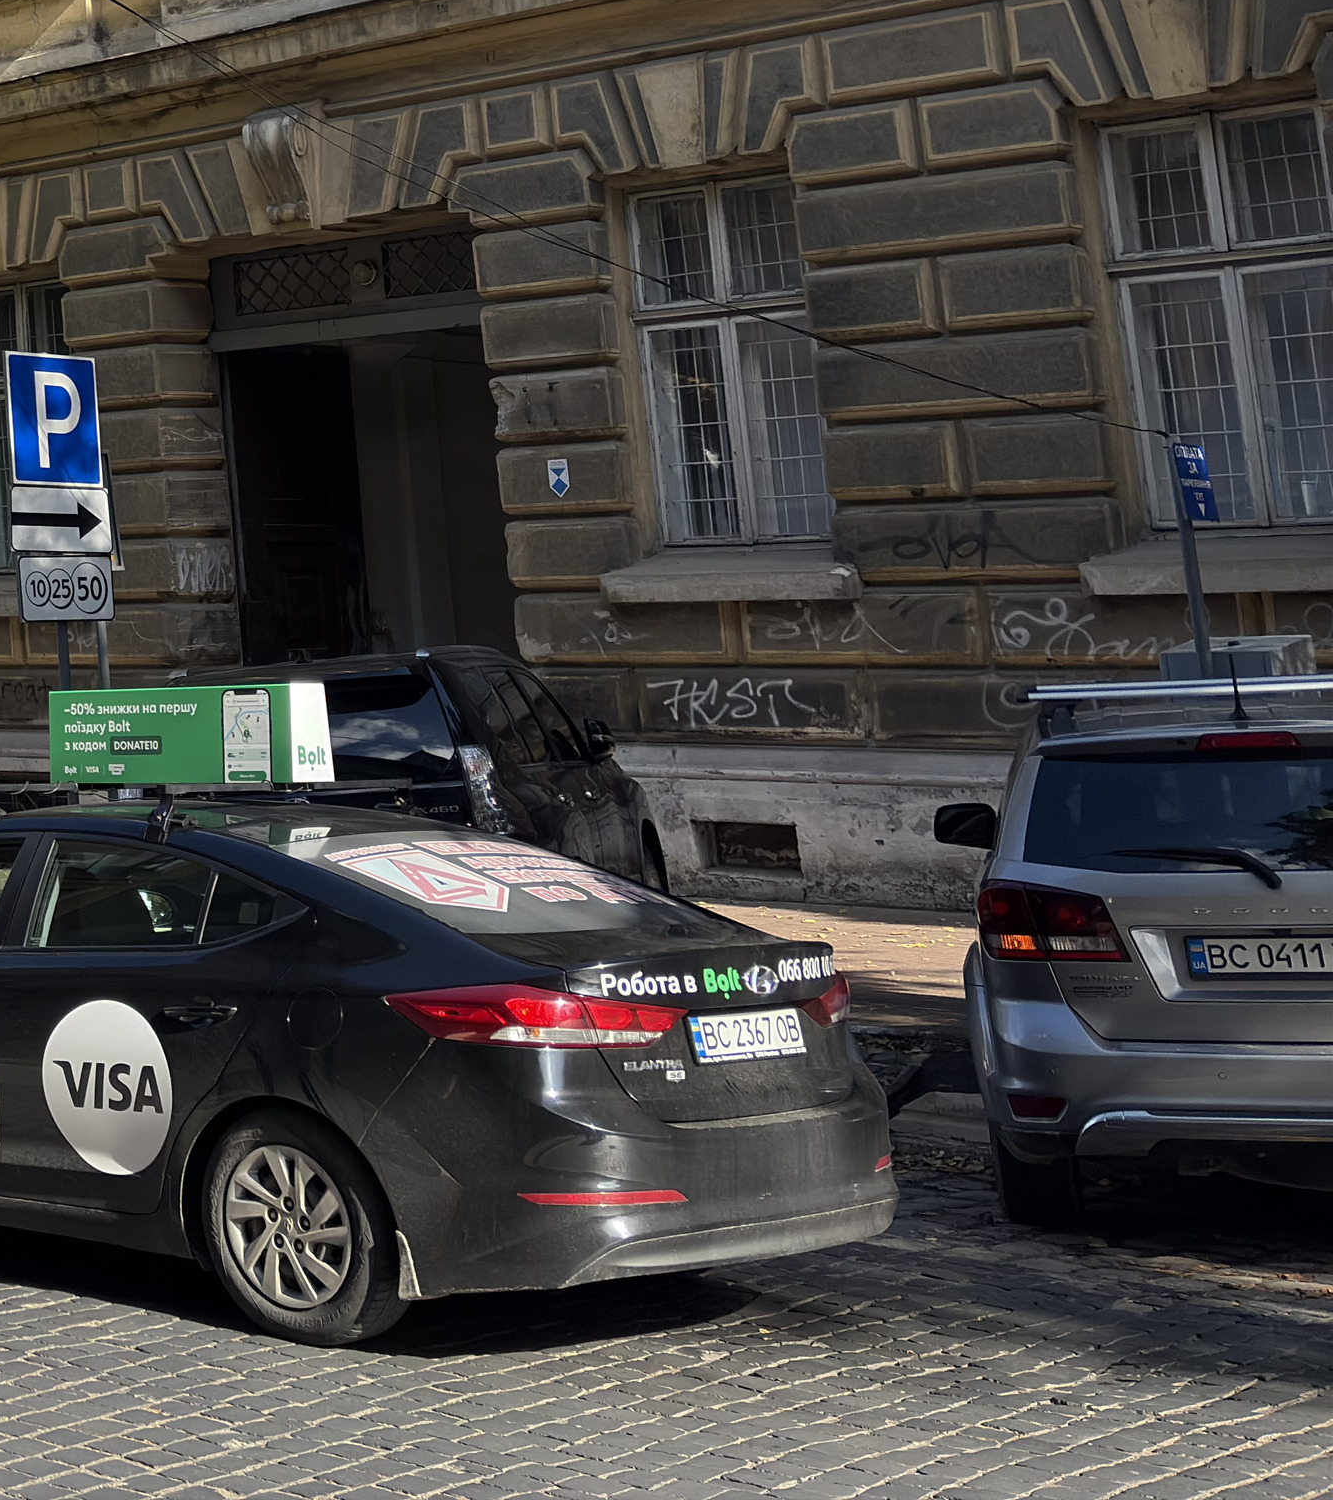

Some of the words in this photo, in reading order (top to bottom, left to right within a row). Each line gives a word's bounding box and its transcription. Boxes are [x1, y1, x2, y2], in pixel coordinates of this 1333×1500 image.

[34, 370, 81, 469] P
[30, 579, 46, 598] 10
[52, 578, 72, 599] 25
[78, 576, 103, 602] 50
[64, 703, 95, 716] -50%
[97, 703, 140, 715] знижки
[142, 703, 157, 714] на
[159, 703, 198, 716] першу
[64, 721, 106, 736] поїздку
[108, 720, 131, 733] Bolt
[64, 740, 71, 751] з
[72, 740, 107, 753] кодом
[113, 740, 159, 751] DONATE10
[297, 745, 327, 771] Bolt
[1193, 961, 1206, 970] UA
[1207, 943, 1250, 969] BC
[1257, 943, 1326, 969] 0411
[600, 971, 681, 997] Робота
[684, 975, 698, 993] в
[703, 967, 743, 1000] Bolt
[778, 958, 802, 982] 066
[802, 956, 821, 980] 800
[702, 1020, 731, 1050] BC
[734, 1016, 772, 1047] 2367
[776, 1014, 801, 1042] OB
[624, 1059, 684, 1071] ELANTRA
[53, 1059, 163, 1114] VISA
